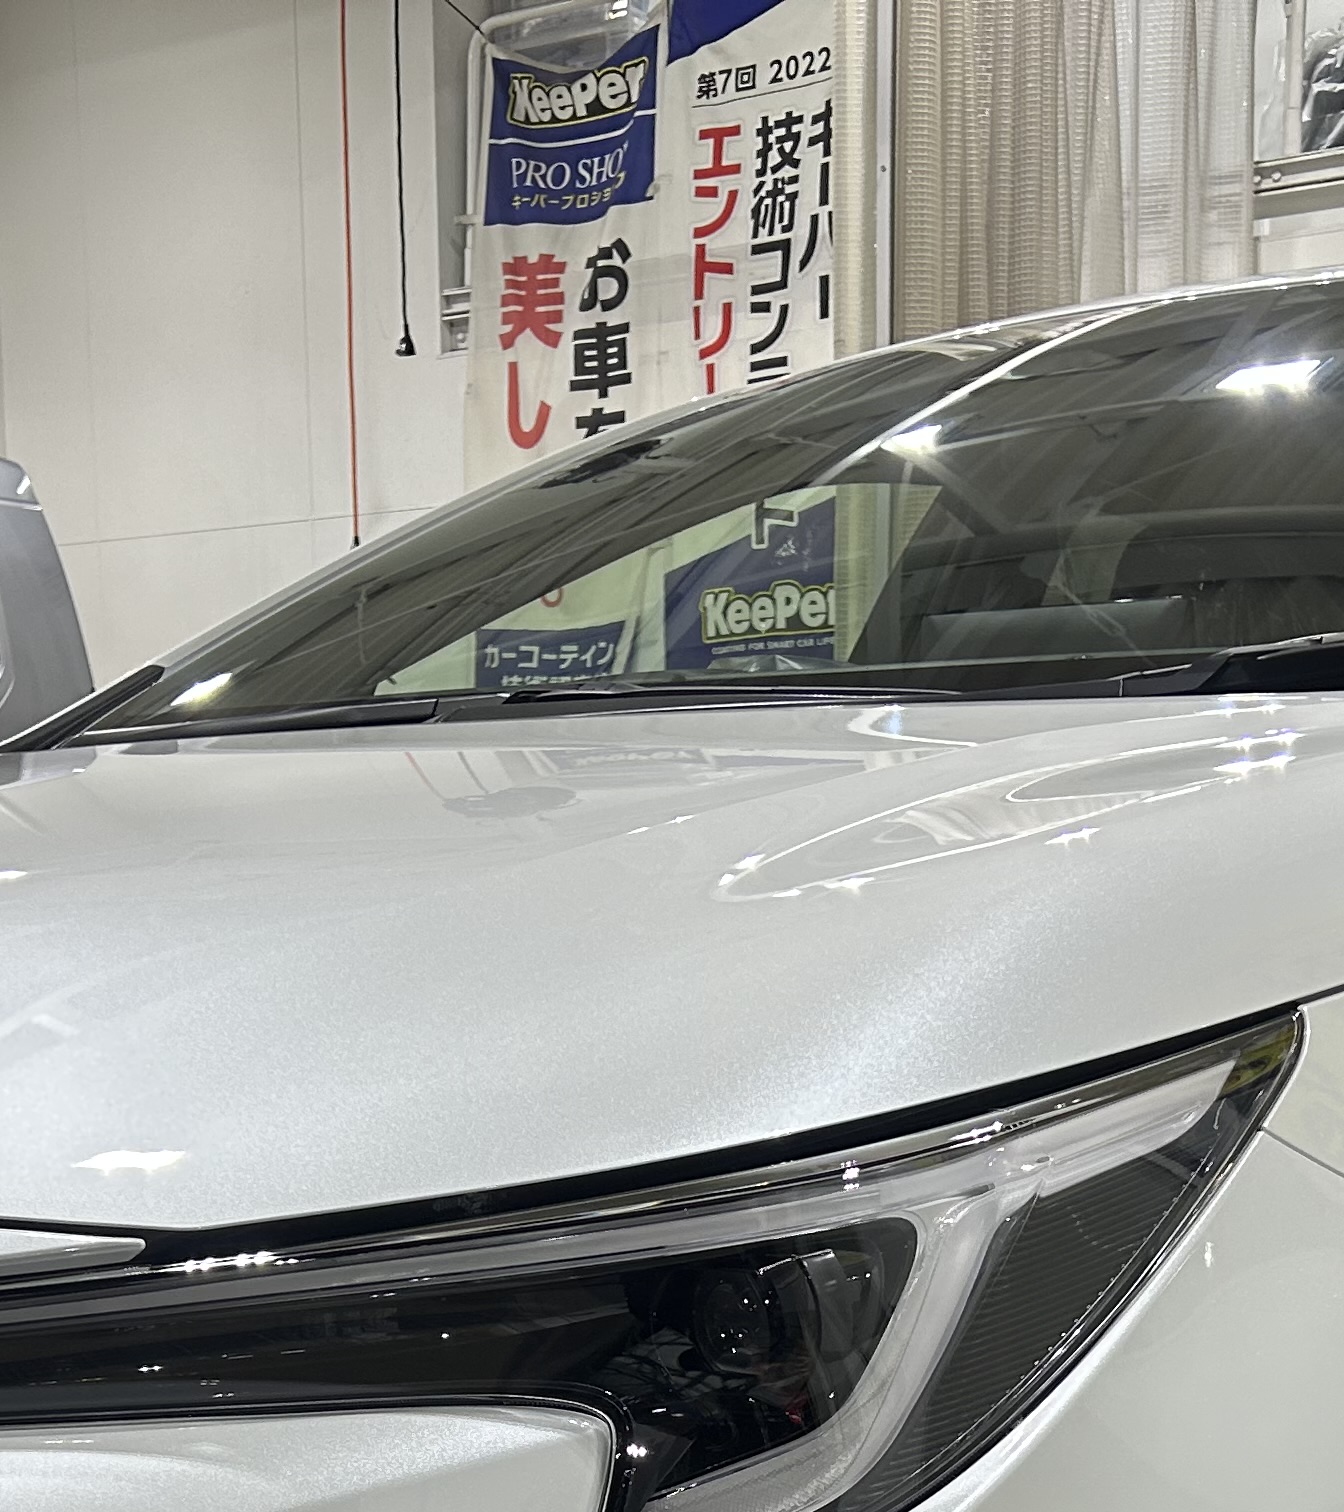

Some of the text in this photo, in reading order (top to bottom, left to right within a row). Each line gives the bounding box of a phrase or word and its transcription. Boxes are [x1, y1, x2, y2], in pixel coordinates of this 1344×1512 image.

[696, 46, 831, 100] 第7回 2022
[511, 158, 571, 190] PRO
[499, 253, 567, 450] 美し
